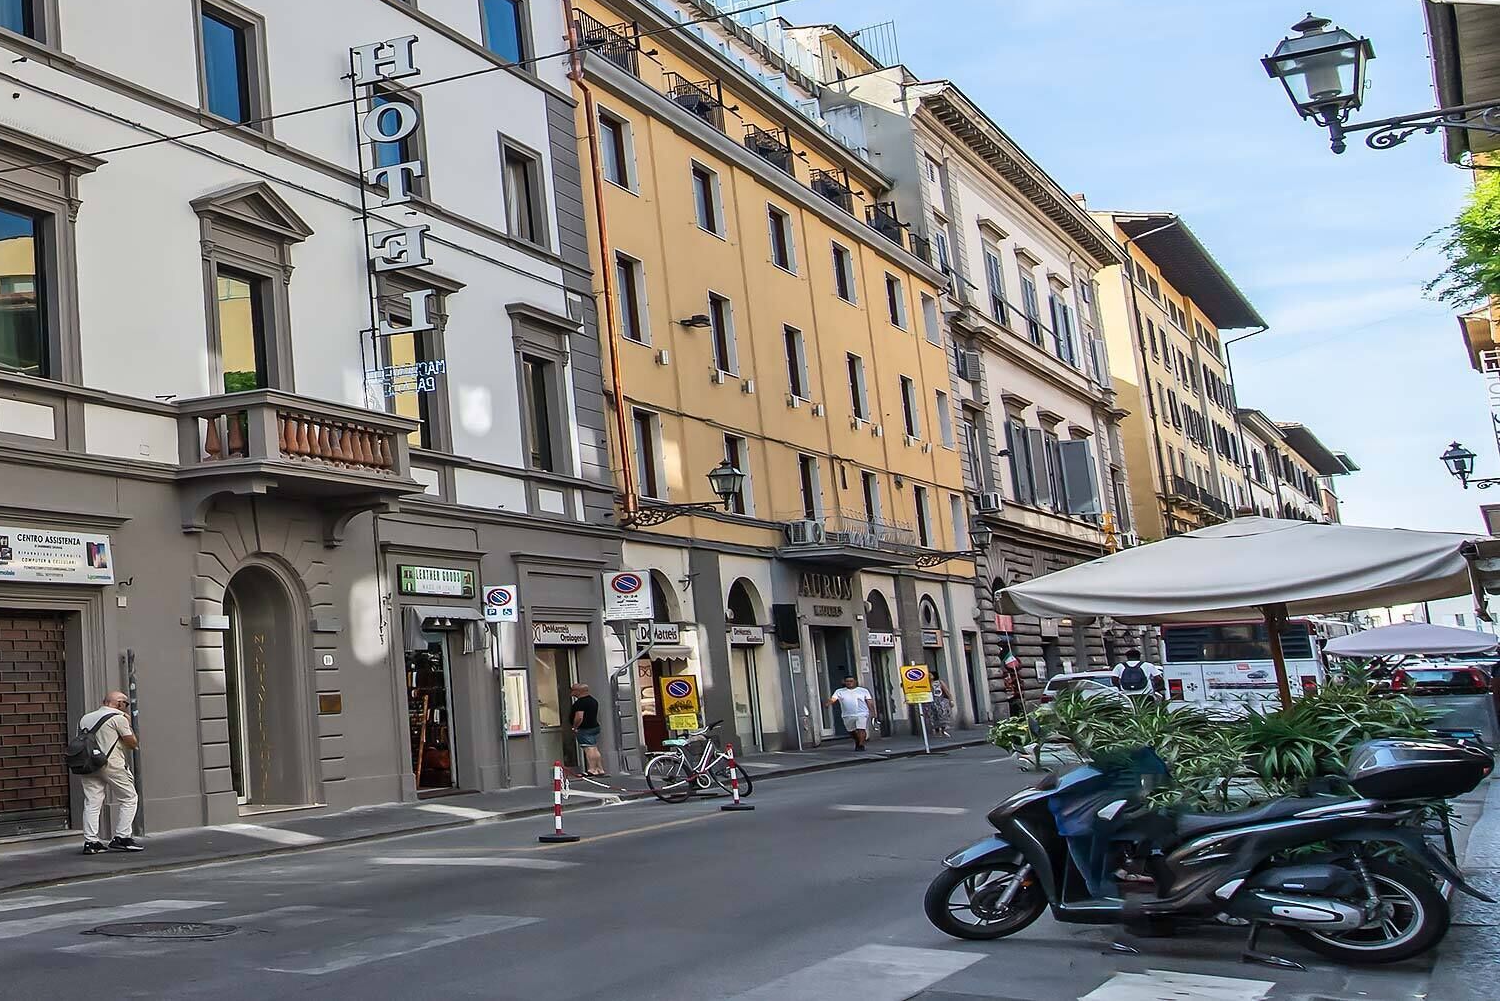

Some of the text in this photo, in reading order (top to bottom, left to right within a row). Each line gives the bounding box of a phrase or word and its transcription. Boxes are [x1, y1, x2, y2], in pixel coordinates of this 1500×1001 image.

[16, 533, 81, 546] CENTRO ASSISTENZA
[799, 573, 853, 601] AURUM
